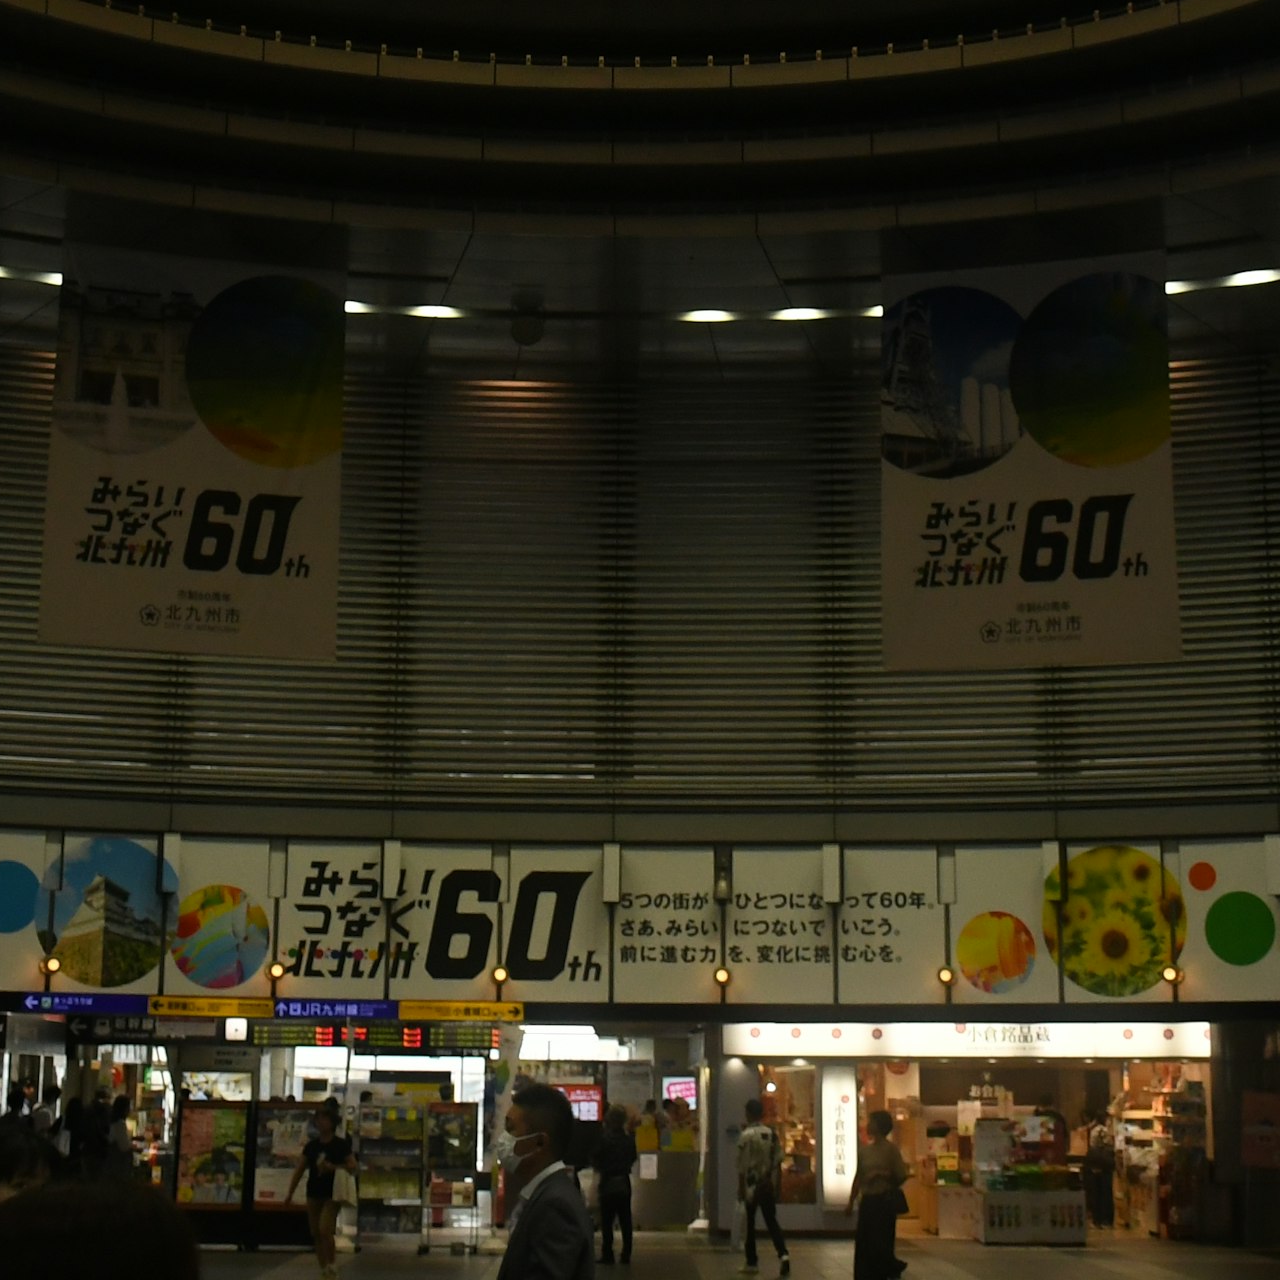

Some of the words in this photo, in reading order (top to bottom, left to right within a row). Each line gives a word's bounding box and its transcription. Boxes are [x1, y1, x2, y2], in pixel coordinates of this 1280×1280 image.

[91, 477, 185, 507] みらい
[85, 508, 183, 538] つなぐ
[926, 500, 1017, 529] みらい
[183, 489, 310, 578] 60th
[920, 524, 1016, 556] つなぐ
[1019, 493, 1149, 583] 60th
[76, 534, 173, 568] 北九州
[915, 556, 1008, 587] 北九州
[166, 605, 240, 624] 北九州市
[1006, 616, 1081, 635] 北九州市
[303, 861, 435, 898] みらい
[294, 900, 430, 939] つなぐ
[425, 870, 602, 981] 60th
[285, 940, 419, 979] 北九州
